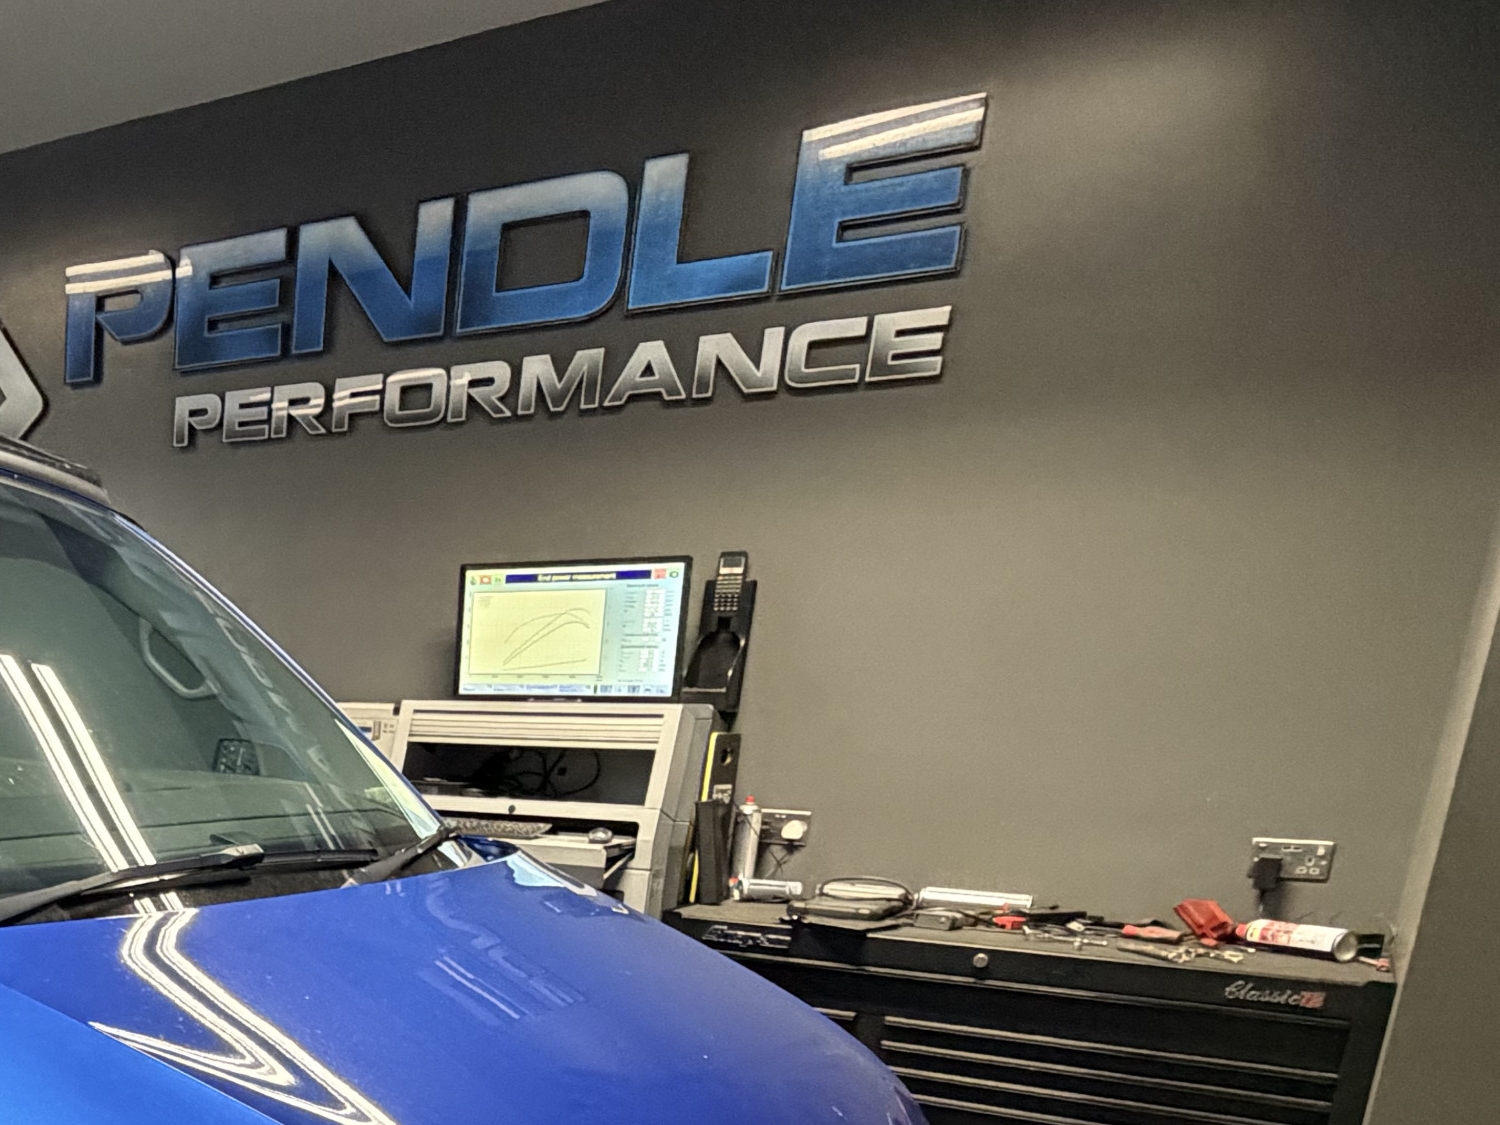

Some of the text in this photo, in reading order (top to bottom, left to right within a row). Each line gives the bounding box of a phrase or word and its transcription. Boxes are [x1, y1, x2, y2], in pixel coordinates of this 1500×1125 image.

[64, 92, 987, 386] PENDLE
[172, 305, 953, 447] PERFORMANCE
[1224, 979, 1301, 1005] Classic
